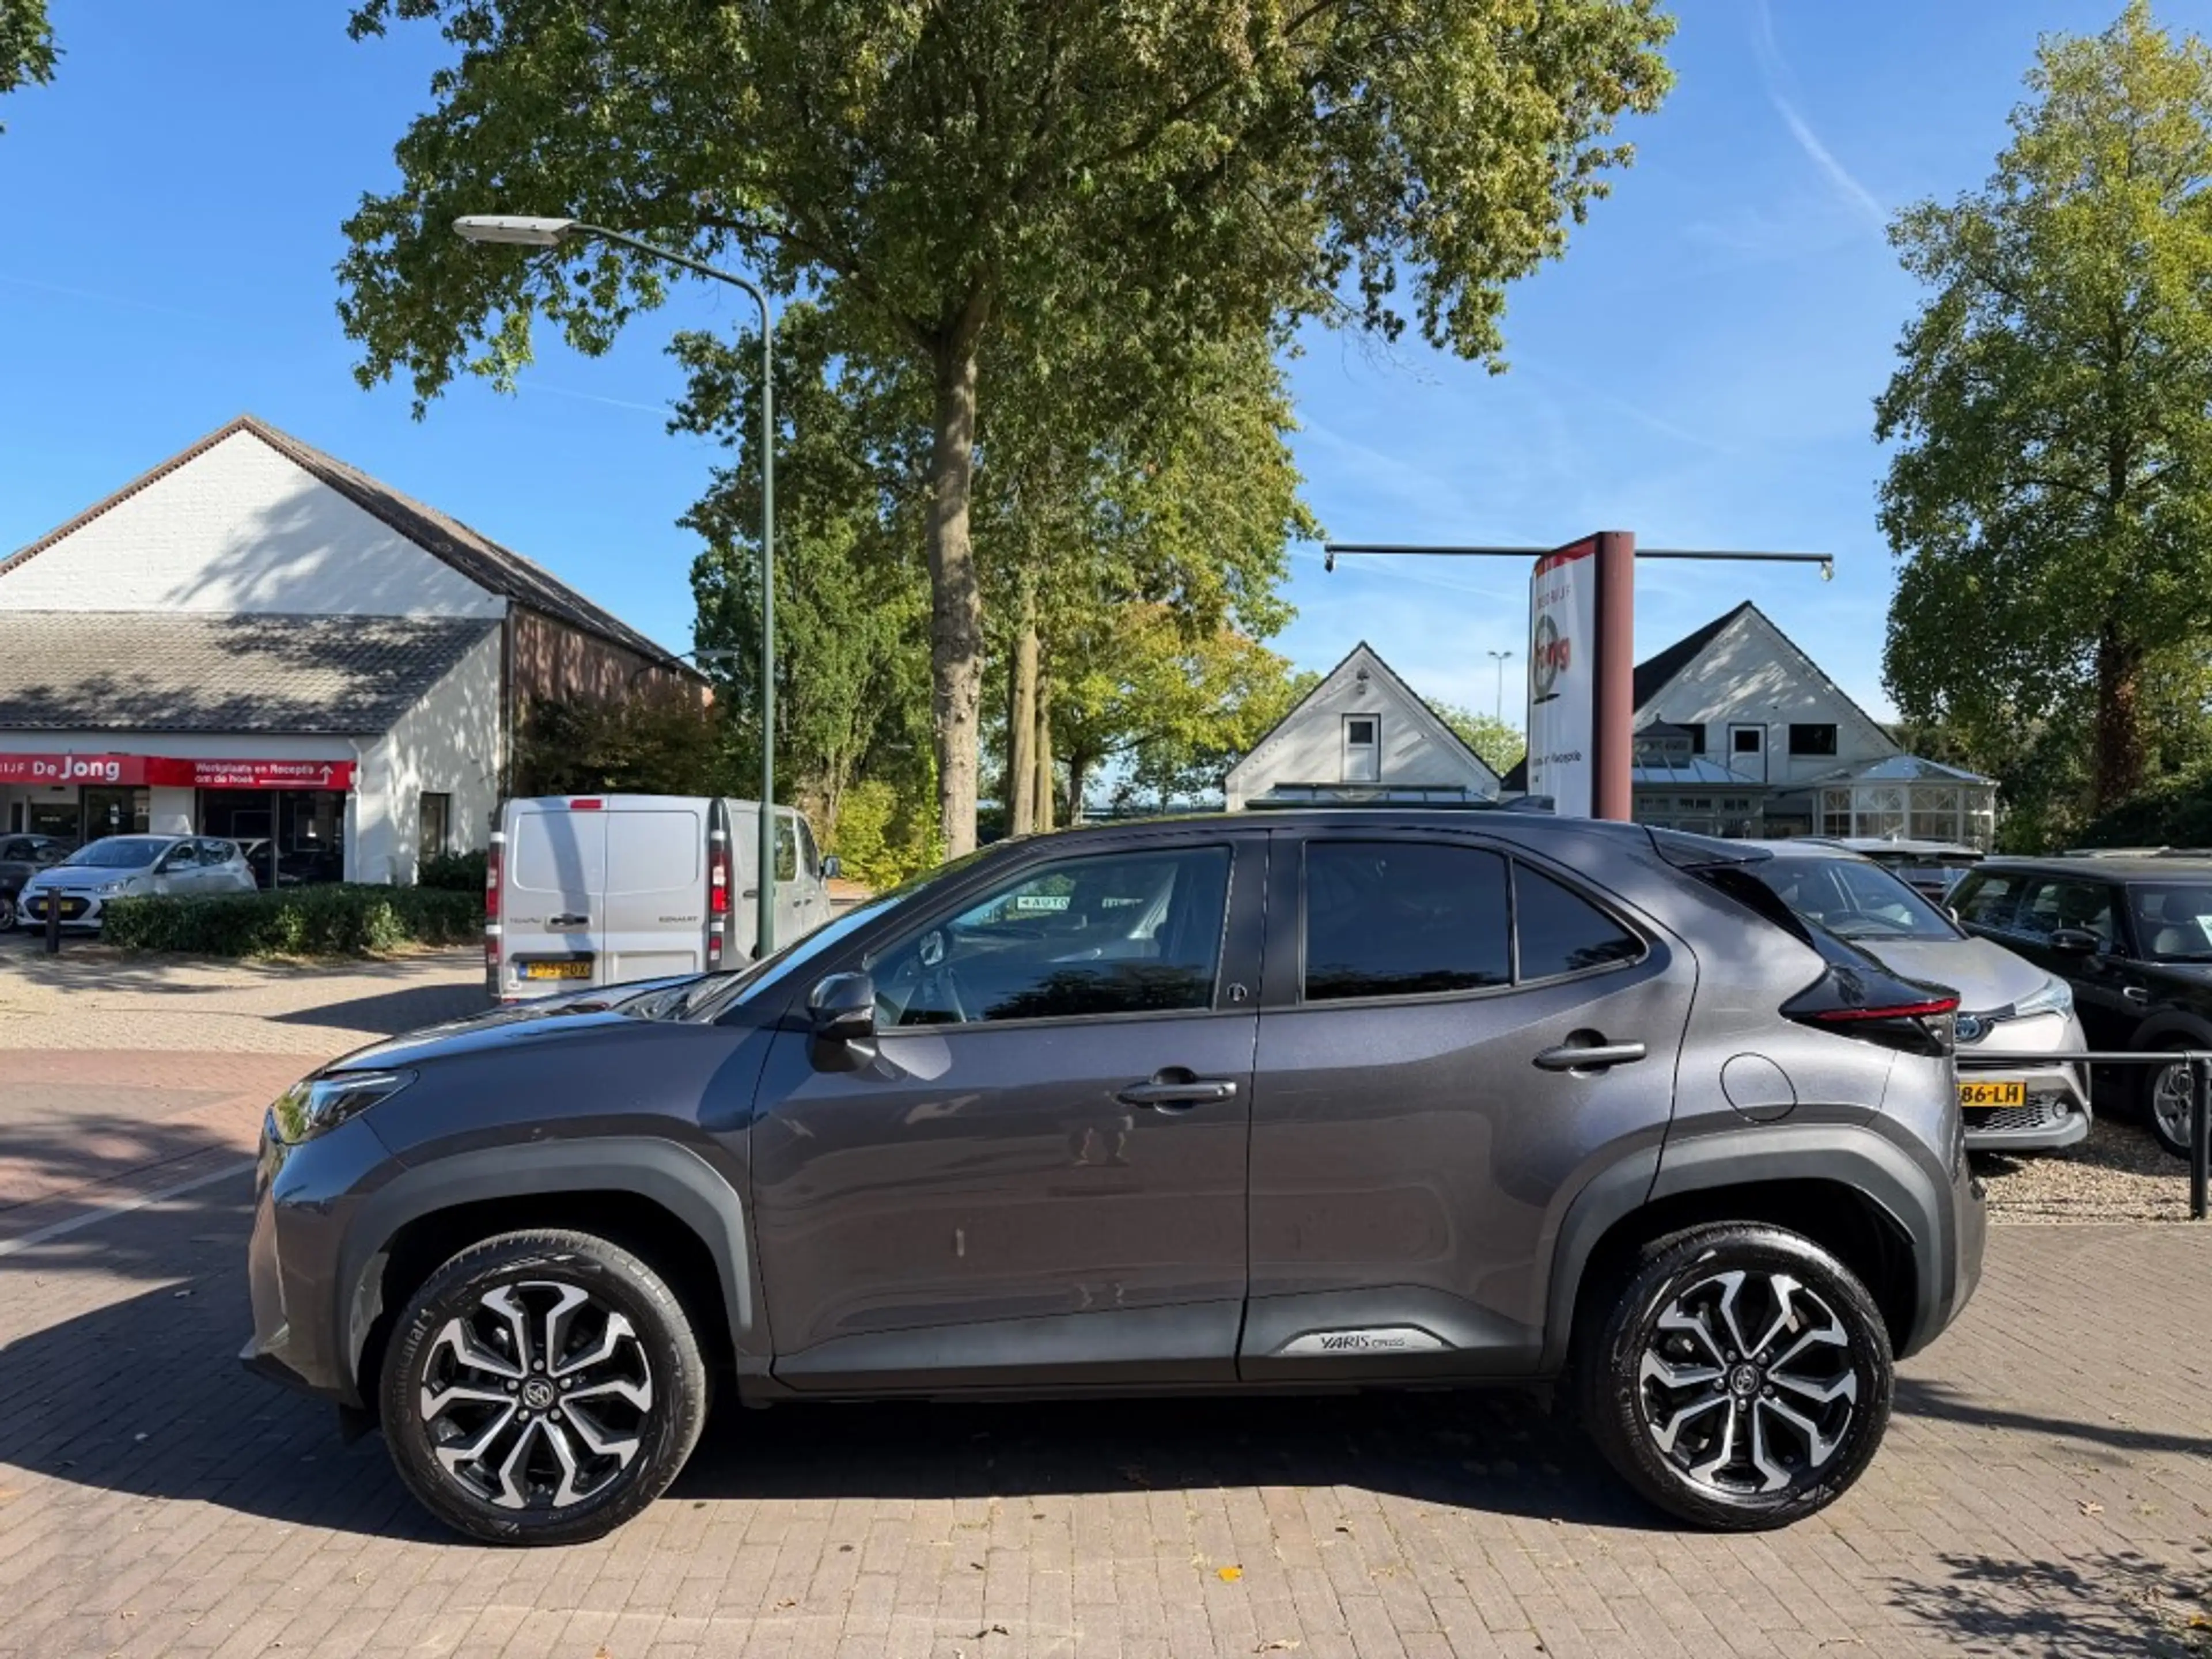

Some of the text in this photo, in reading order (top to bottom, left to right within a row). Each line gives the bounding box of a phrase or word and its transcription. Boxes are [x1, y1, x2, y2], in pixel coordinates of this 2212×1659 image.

[33, 760, 56, 775] De
[59, 755, 120, 782] Jong
[1957, 1085, 2018, 1103] 86-LH
[1321, 1335, 1370, 1349] YARIS
